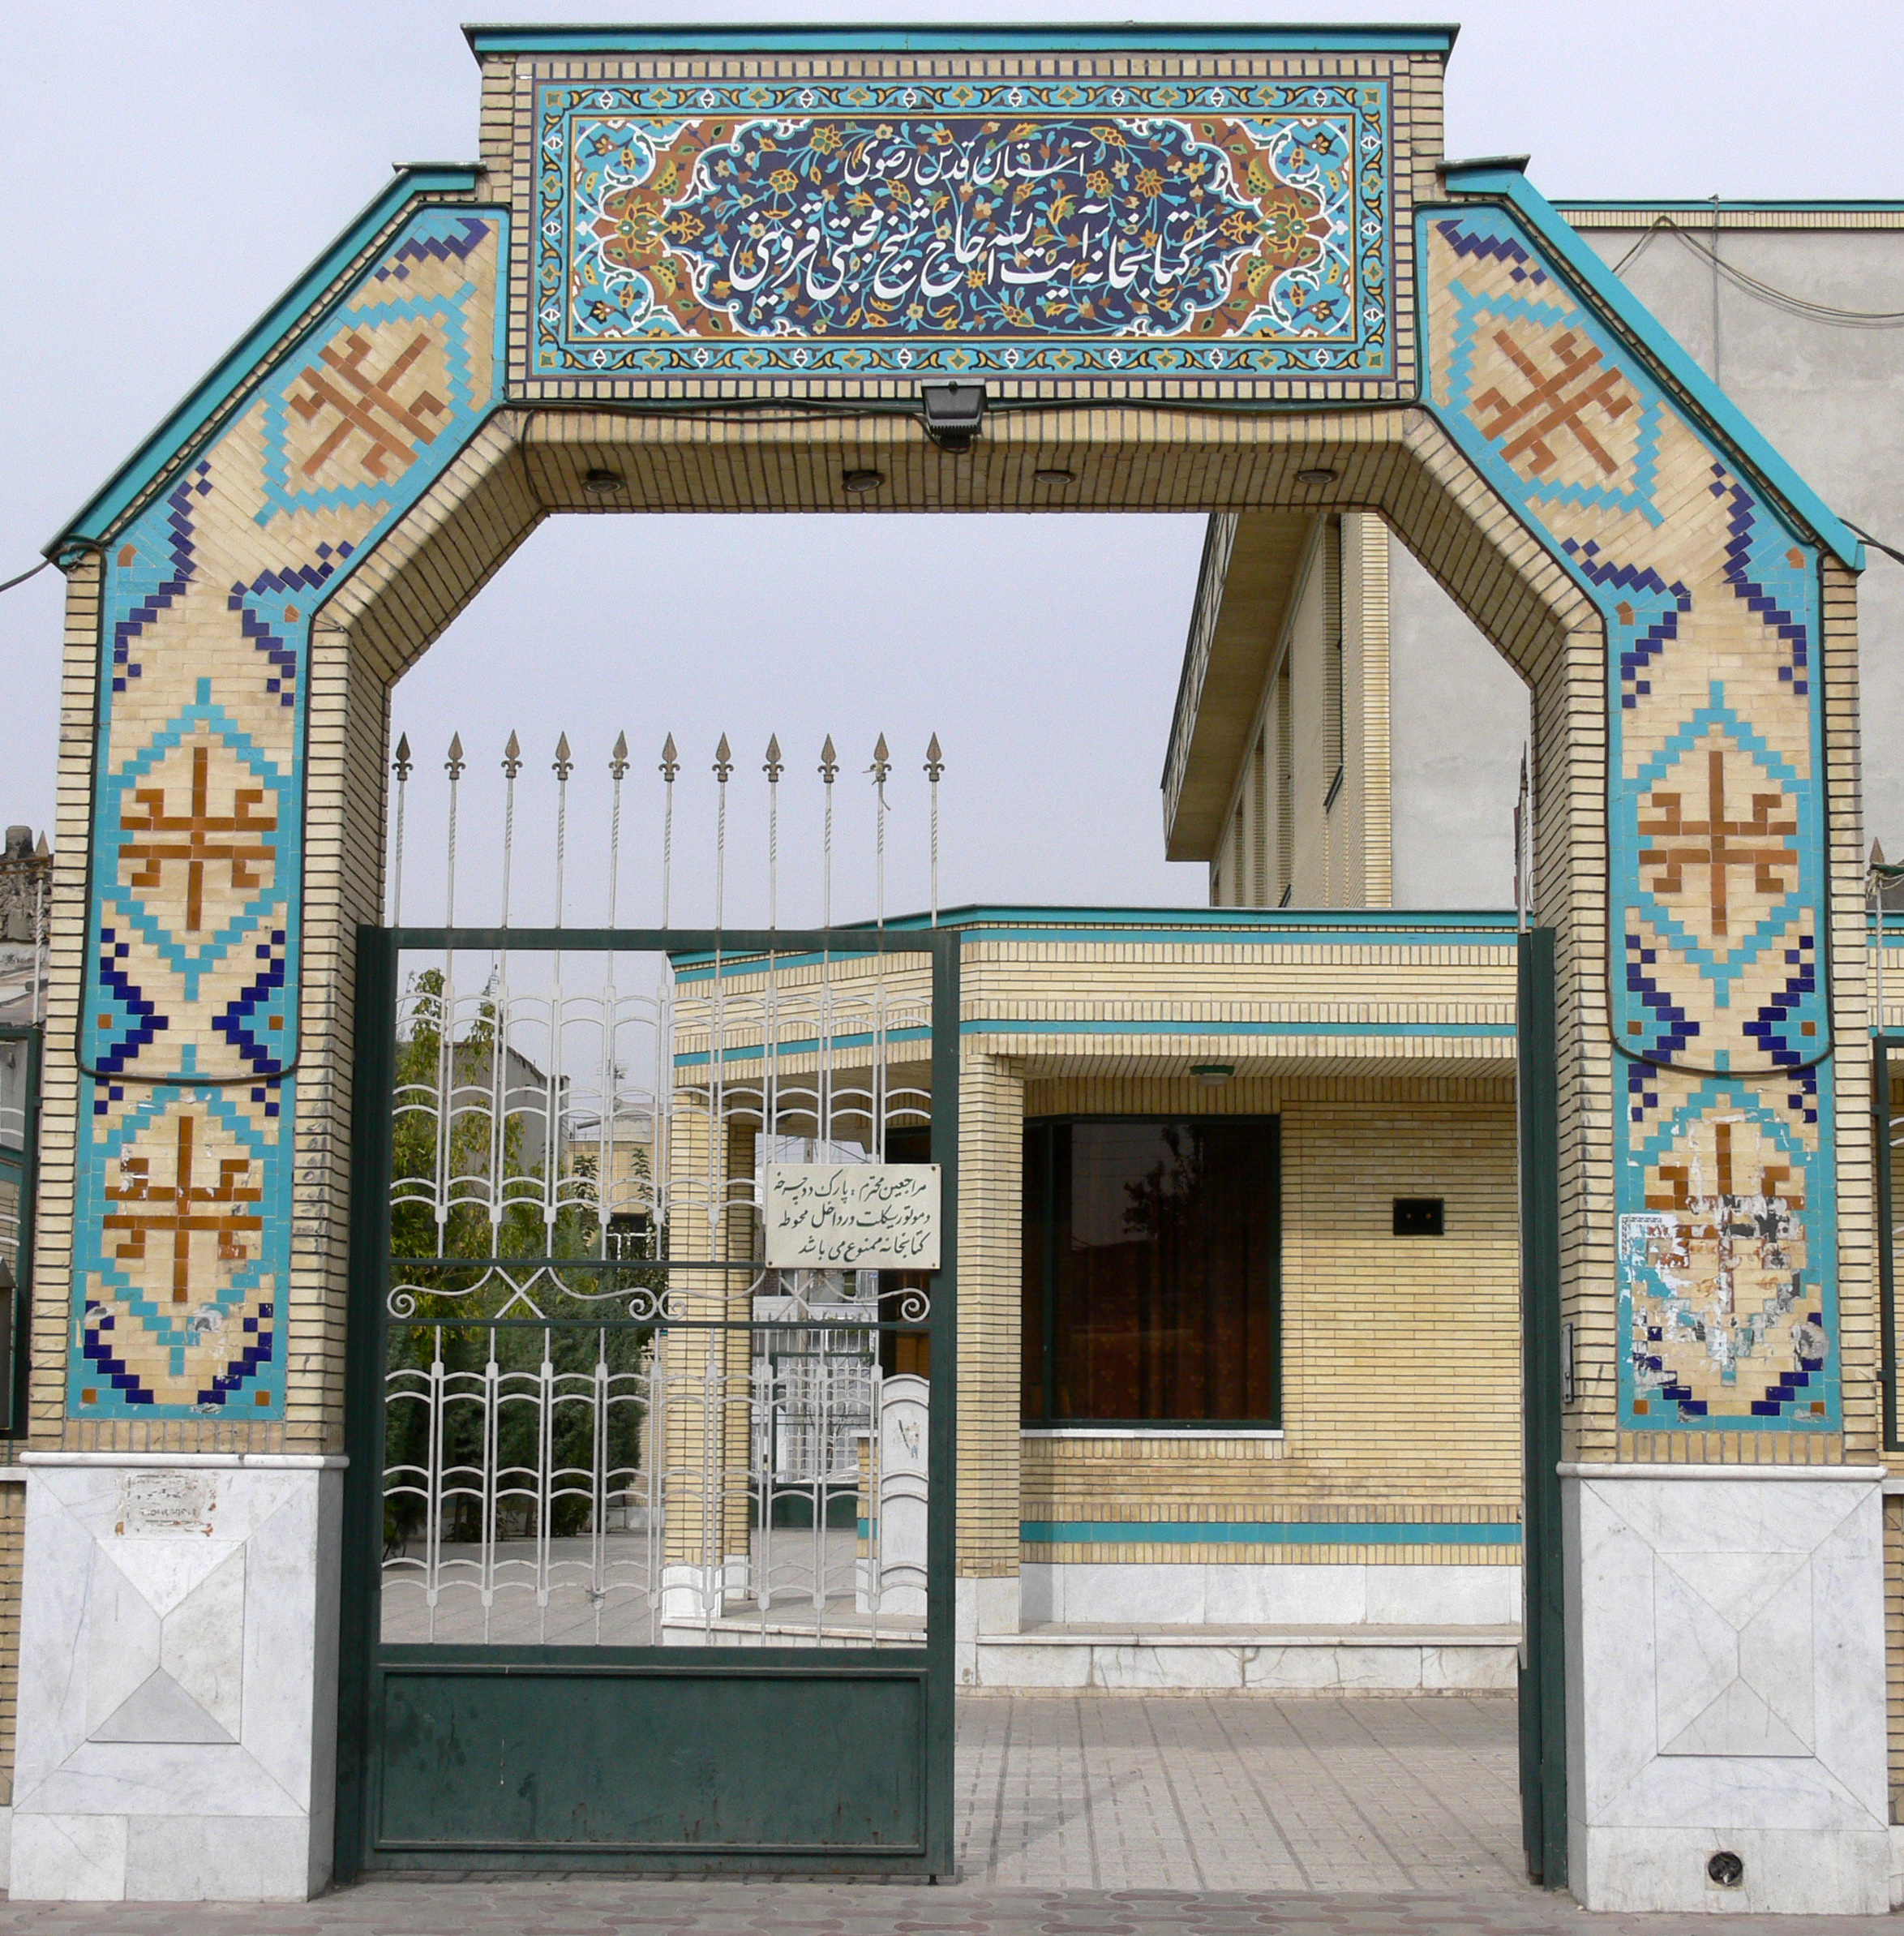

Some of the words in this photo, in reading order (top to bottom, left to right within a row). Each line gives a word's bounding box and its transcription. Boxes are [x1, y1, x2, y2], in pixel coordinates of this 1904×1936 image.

[844, 136, 912, 186] رضوی
[914, 140, 975, 186] قدس
[973, 140, 1092, 186] آستان
[729, 201, 821, 307] قزوینی
[806, 208, 885, 301] مجتبی
[873, 197, 930, 299] شیخ
[920, 214, 986, 298] حاج
[987, 209, 1034, 285] الله
[814, 1169, 848, 1204] پارک
[878, 1178, 927, 1200] مراجعین
[778, 1209, 808, 1229] محوطه
[843, 1237, 882, 1262] ممنوع
[879, 1230, 931, 1259] کتابخانه
